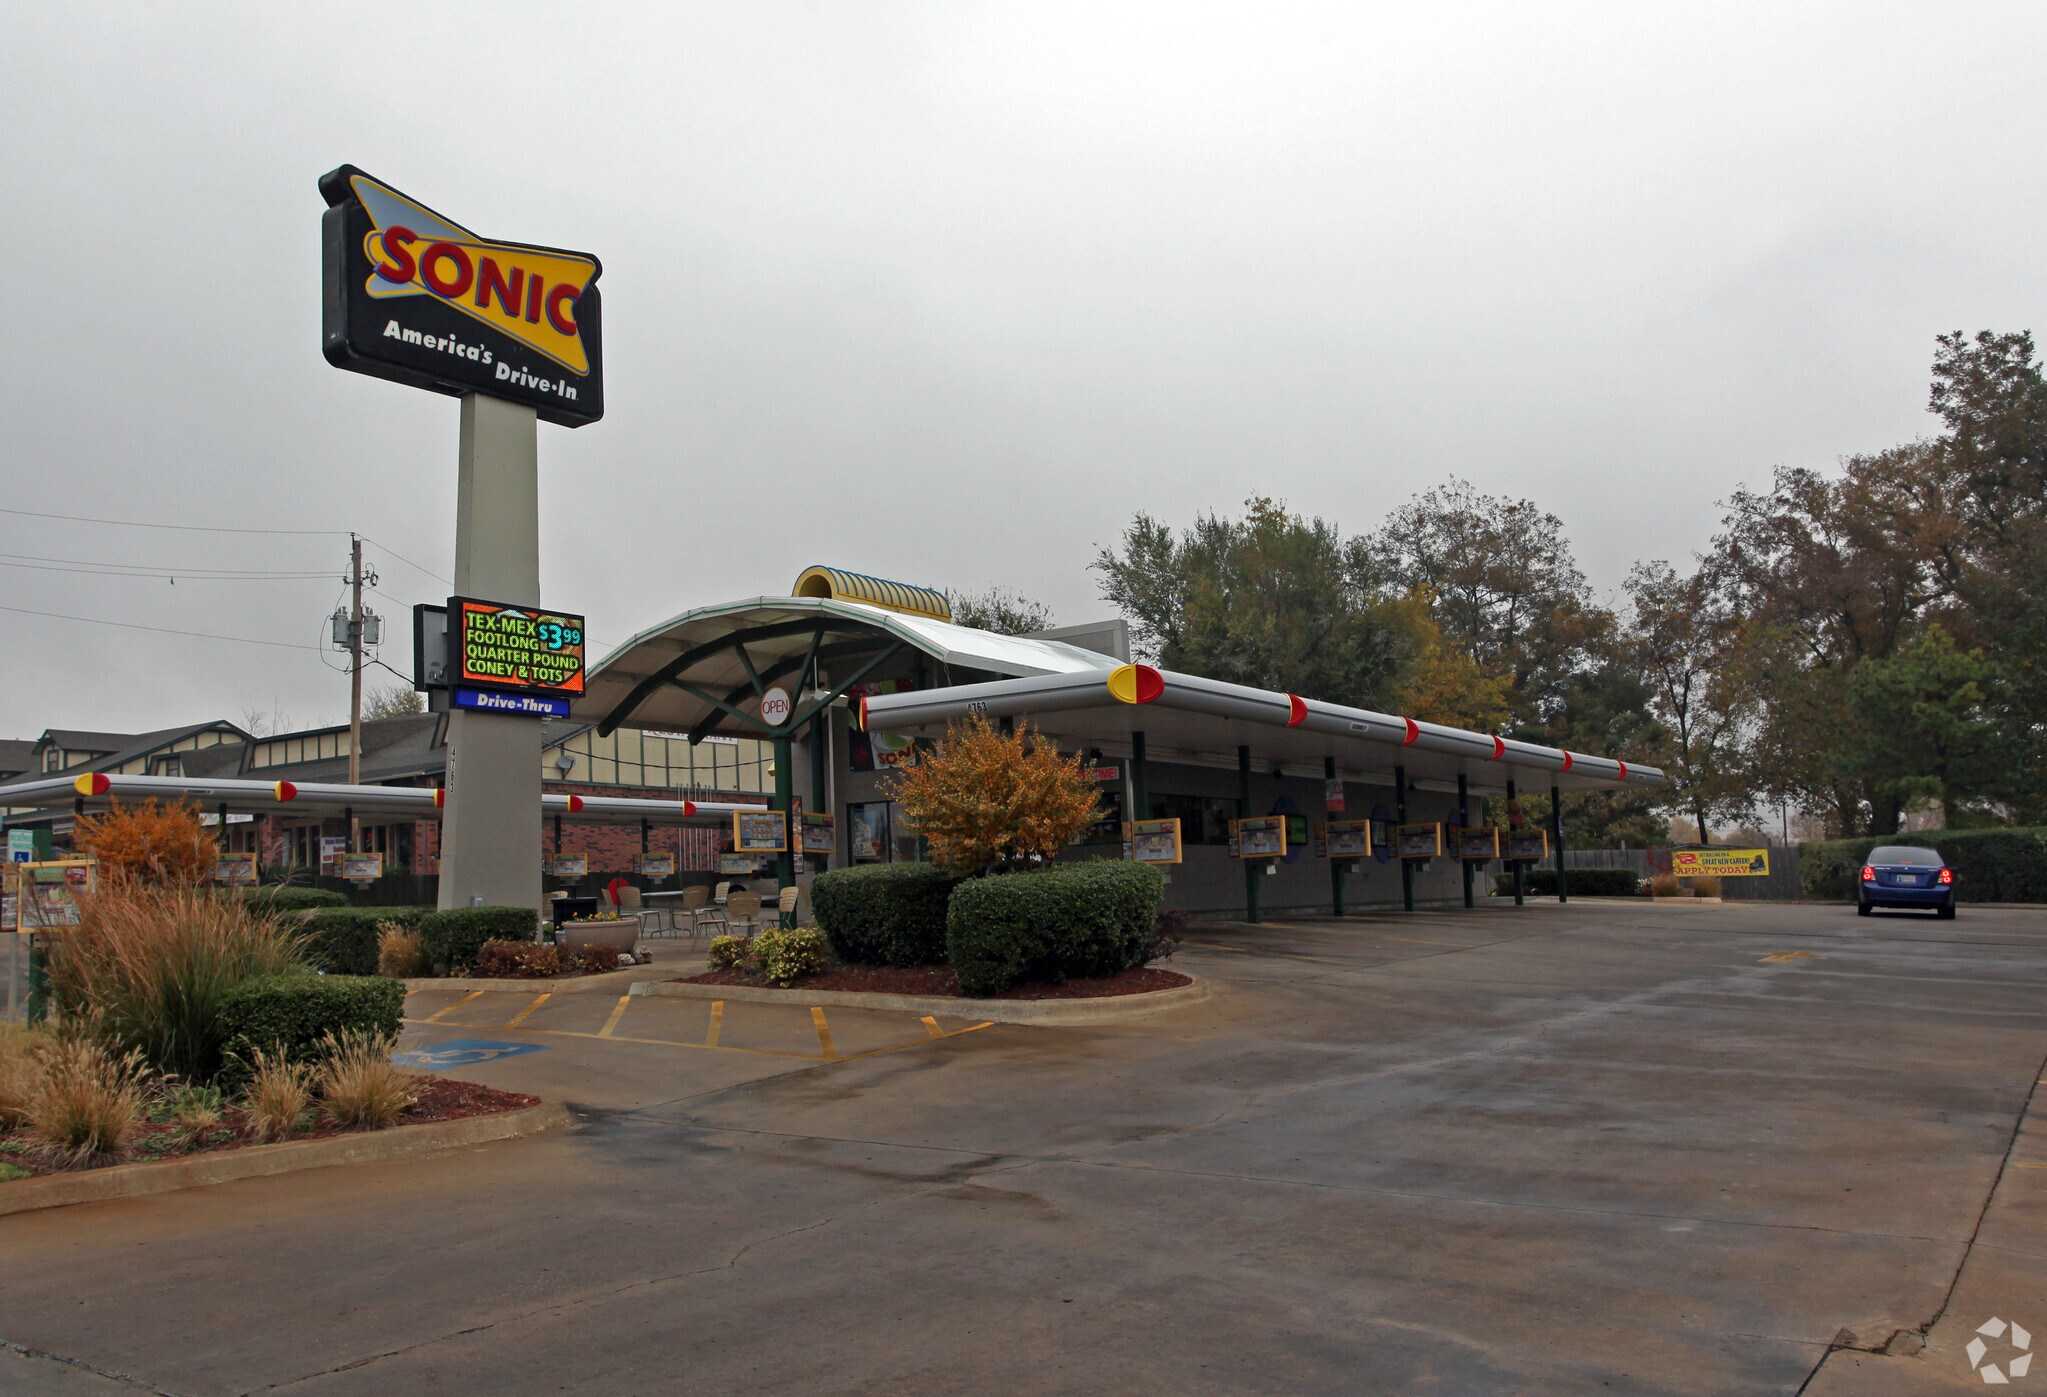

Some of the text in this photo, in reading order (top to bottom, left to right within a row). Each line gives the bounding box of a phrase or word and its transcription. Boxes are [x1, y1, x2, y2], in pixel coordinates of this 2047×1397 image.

[373, 225, 580, 336] SONIC
[383, 320, 492, 364] America's
[466, 612, 537, 636] TEX-MEX
[467, 629, 539, 650] FOOTLONG
[467, 644, 579, 670] QUARTER POUND
[467, 659, 563, 682] CONEY & TOTS
[477, 693, 553, 713] Drive-Thru
[762, 699, 789, 714] OPEN
[967, 702, 988, 712] 4763
[1677, 866, 1748, 875] APPLY TODAY
